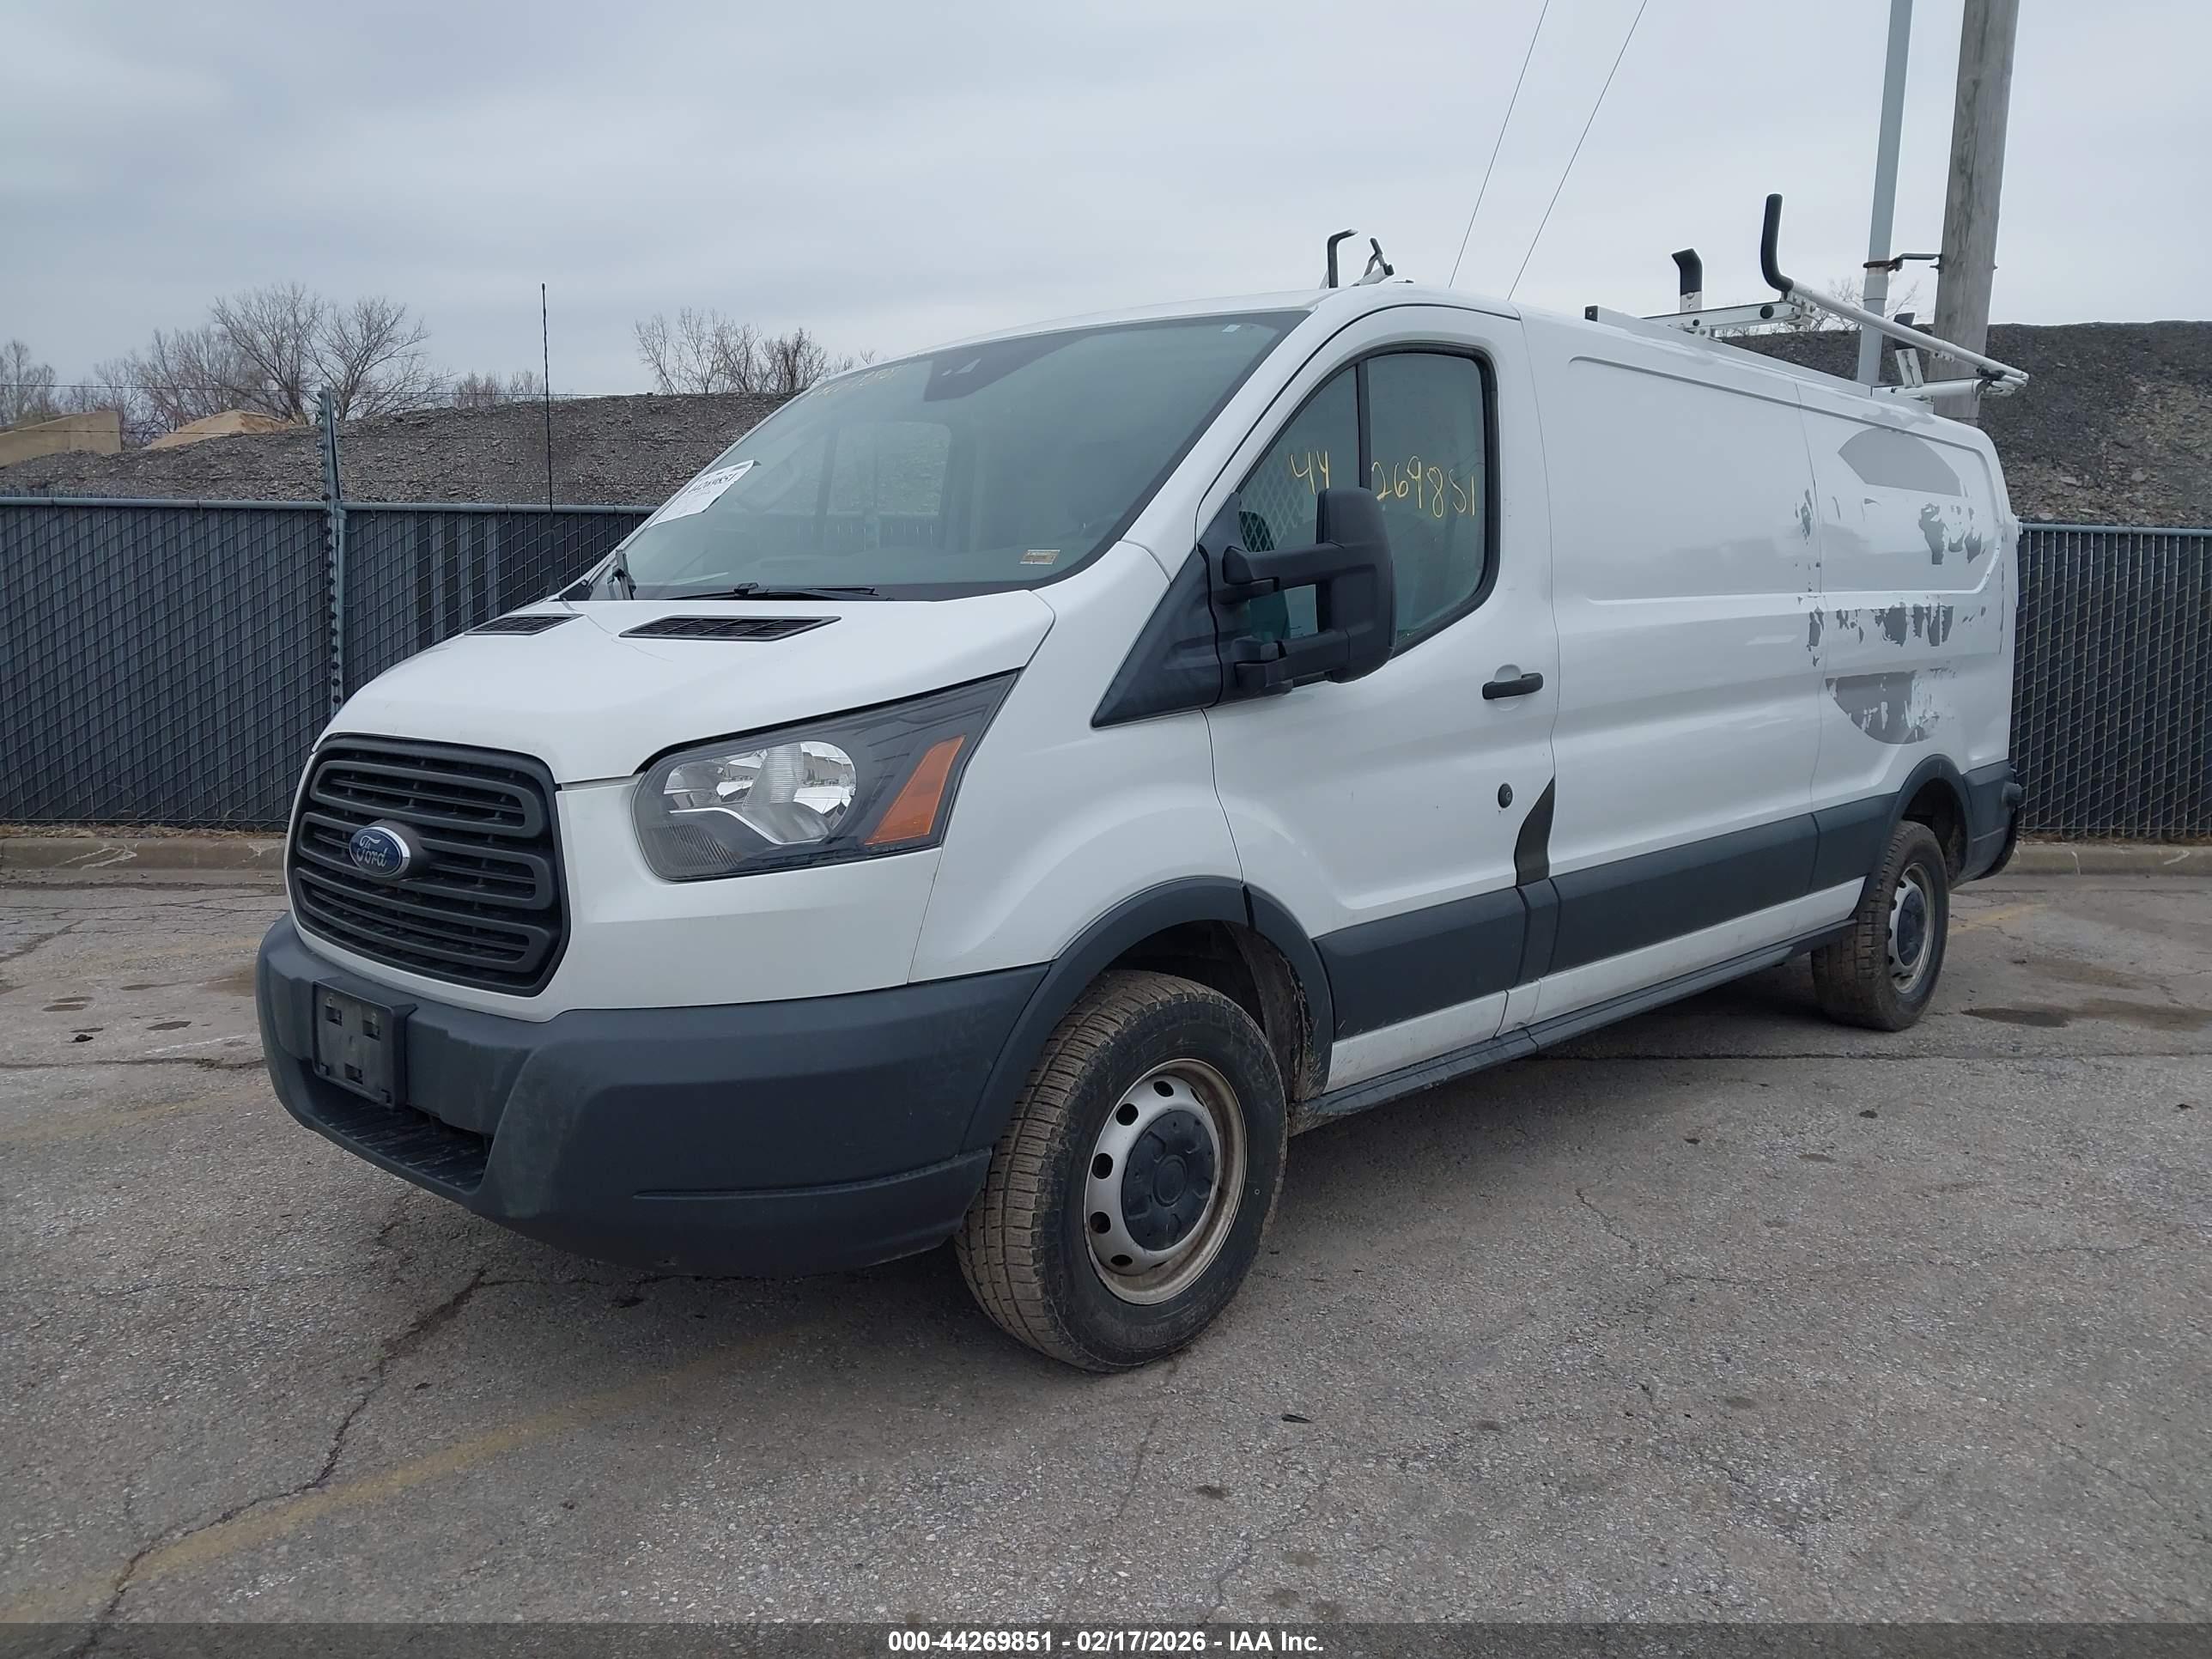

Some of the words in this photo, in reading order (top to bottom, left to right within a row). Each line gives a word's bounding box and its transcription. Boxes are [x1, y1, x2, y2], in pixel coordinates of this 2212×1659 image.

[1290, 449, 1330, 495] 44
[1370, 455, 1475, 519] 269851
[356, 835, 389, 867] Ford
